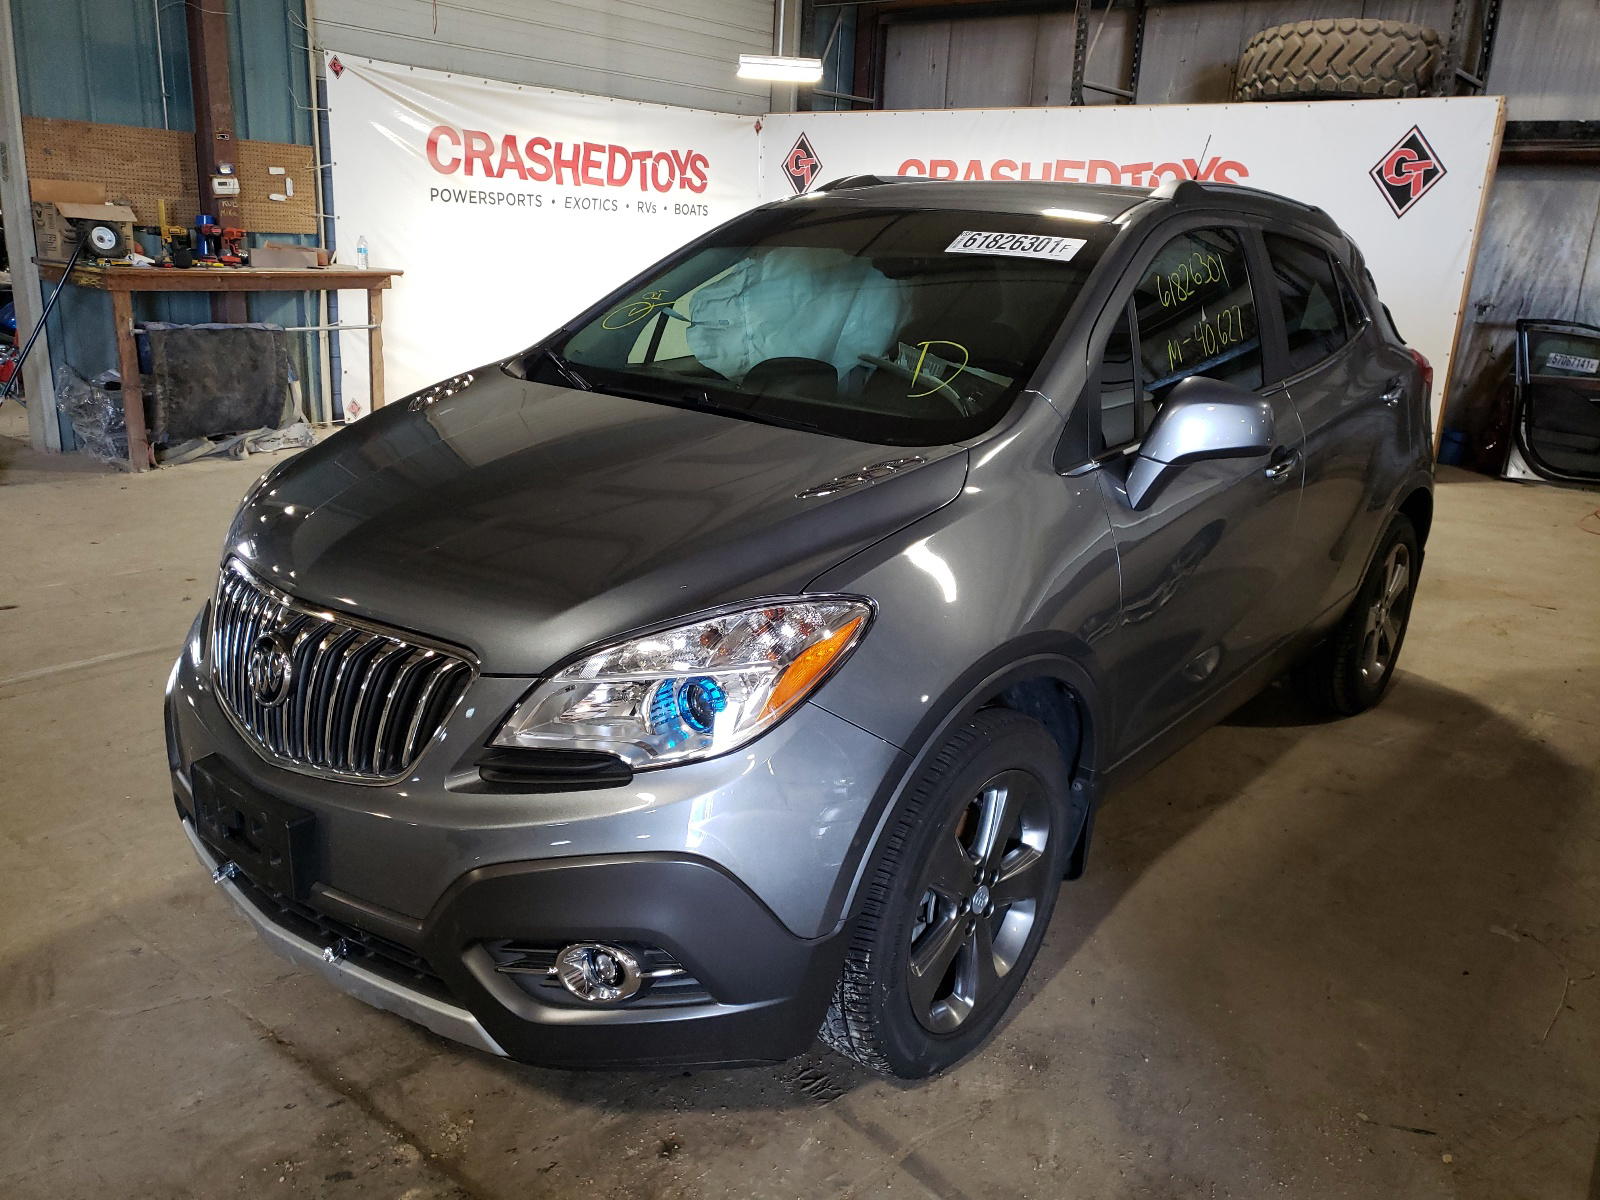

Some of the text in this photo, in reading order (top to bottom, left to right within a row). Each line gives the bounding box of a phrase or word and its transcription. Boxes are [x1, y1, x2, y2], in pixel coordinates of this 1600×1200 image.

[426, 125, 710, 194] CRASHEDTOYS
[430, 187, 709, 217] POWERSPORTS EXOTICS RVs BOATS
